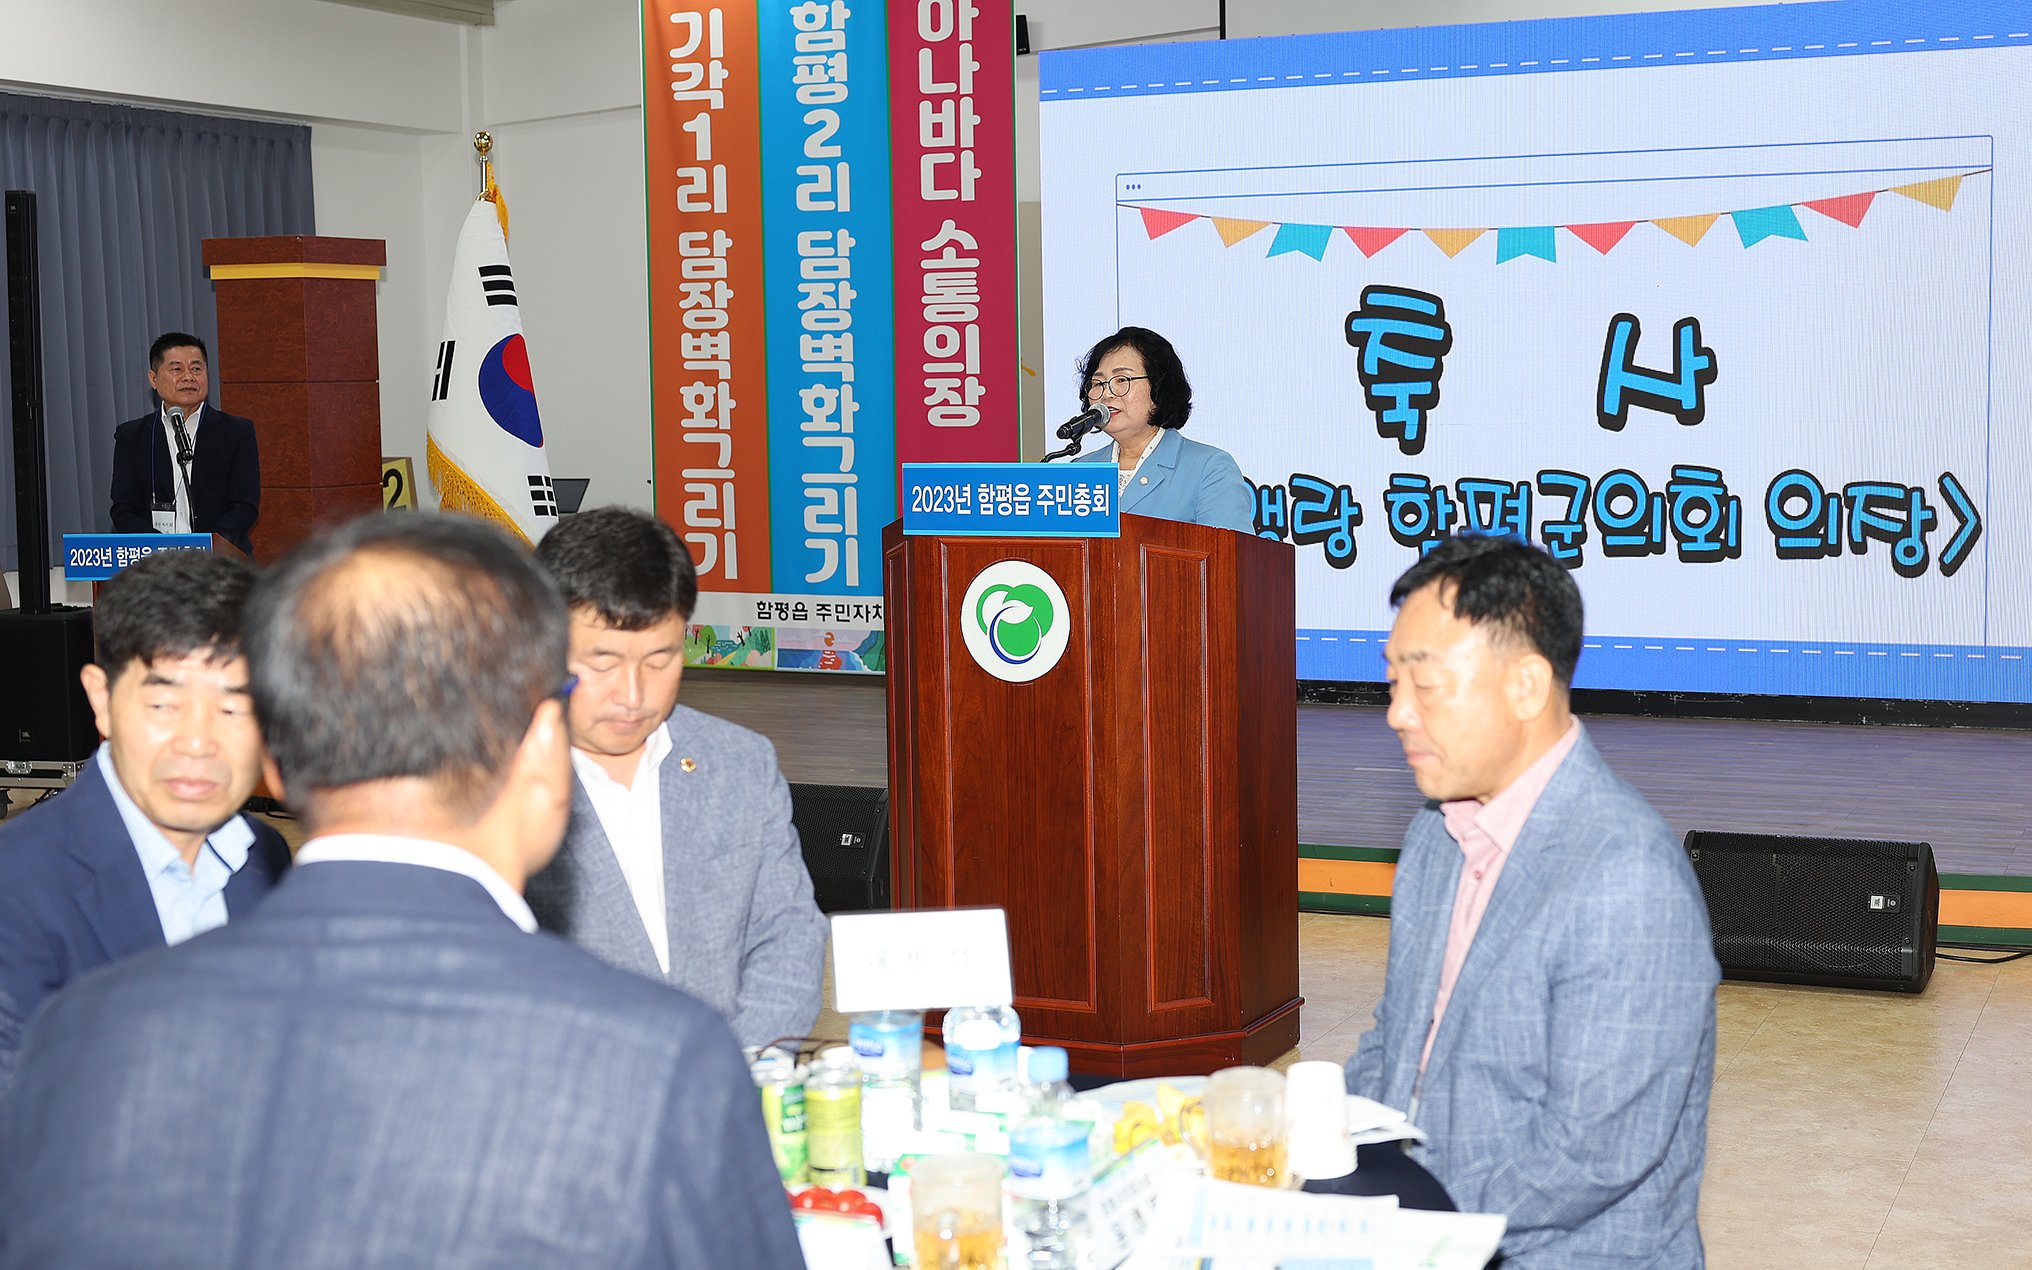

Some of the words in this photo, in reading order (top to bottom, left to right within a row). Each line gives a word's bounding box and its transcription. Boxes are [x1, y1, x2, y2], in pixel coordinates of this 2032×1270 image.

[669, 8, 729, 214] 기각1리
[789, 0, 851, 213] 함평2리
[917, 0, 982, 202] 아나바다
[678, 229, 738, 580] 담장벽화그리기
[796, 228, 860, 587] 담장벽화그리기
[920, 219, 987, 427] 소통의장
[1345, 284, 1453, 454] 축
[1597, 312, 1718, 431] 사
[70, 547, 113, 568] 2023년
[911, 484, 972, 515] 2023년
[977, 483, 1032, 516] 함평읍
[1036, 483, 1110, 517] 주민총회
[756, 601, 808, 621] 함평읍
